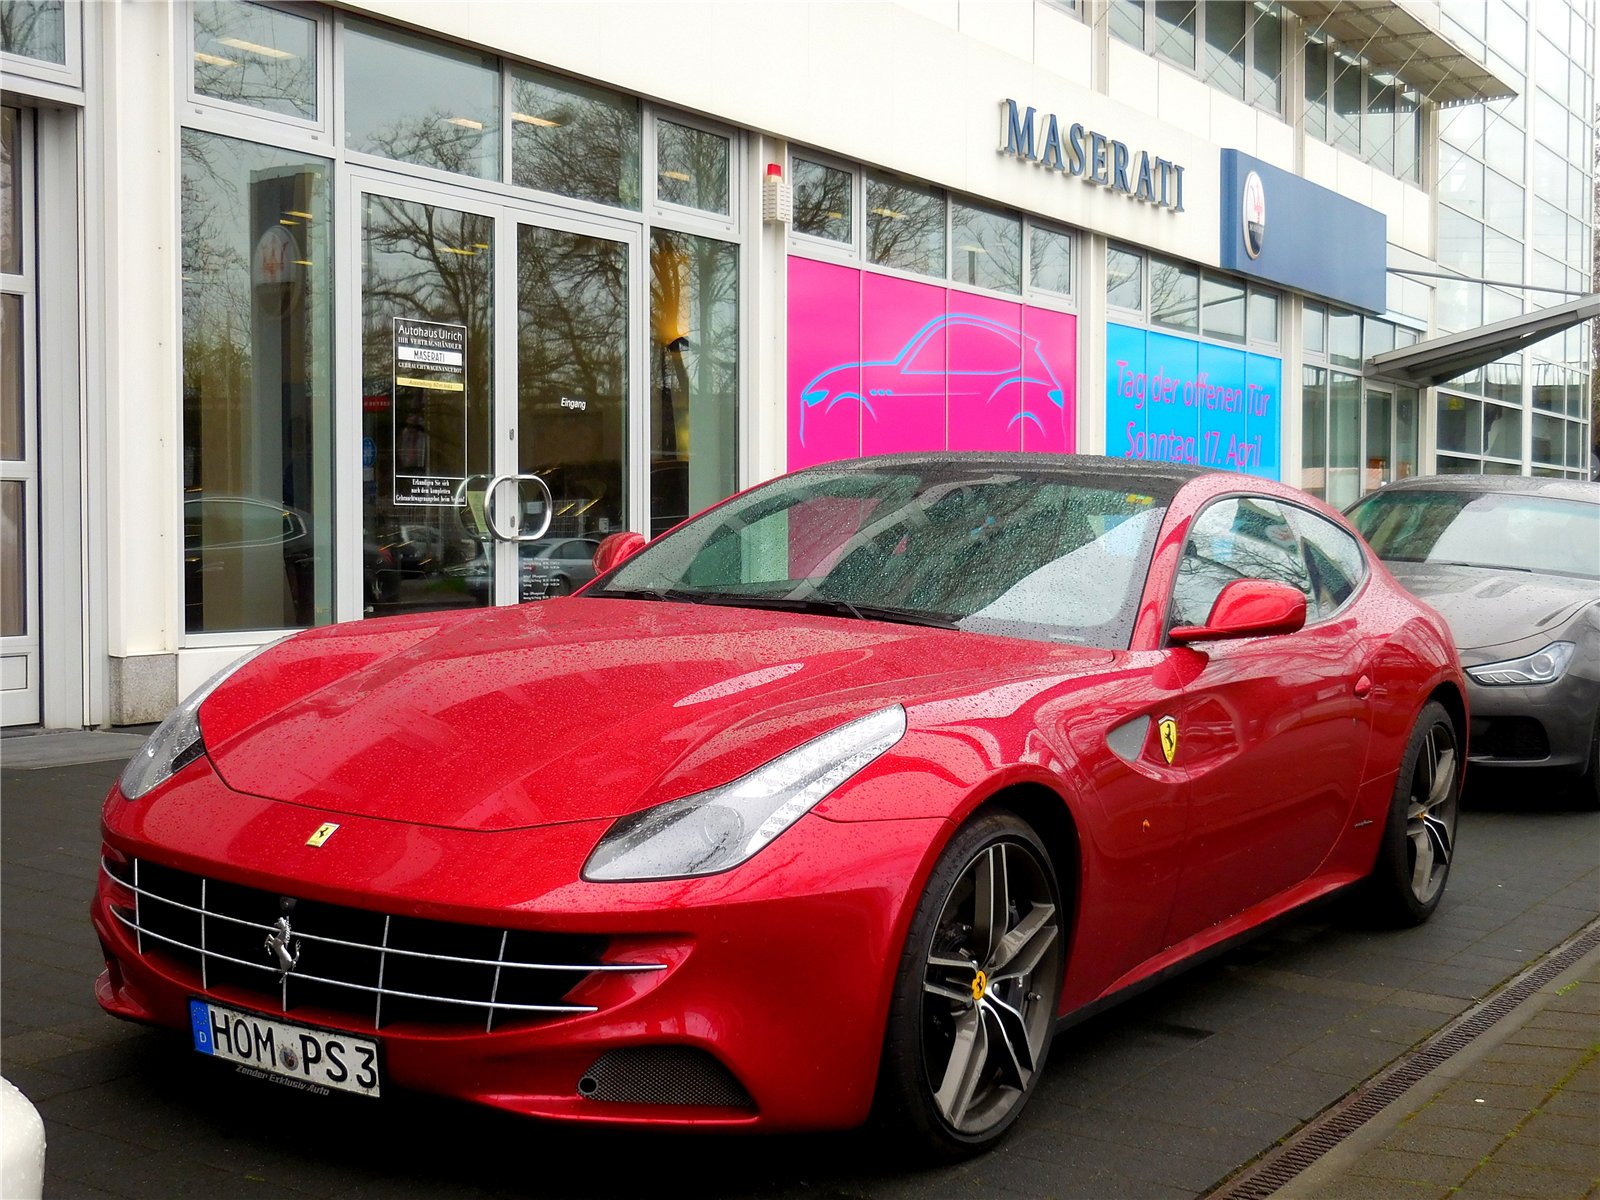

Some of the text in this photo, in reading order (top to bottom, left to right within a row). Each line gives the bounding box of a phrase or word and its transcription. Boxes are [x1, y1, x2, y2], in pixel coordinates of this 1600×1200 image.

[1000, 98, 1185, 213] MASERATI
[398, 325, 463, 341] Autohaus Ulrich
[413, 350, 446, 363] MASERATI
[1116, 359, 1271, 417] Tag der offenen Tür
[560, 397, 587, 411] Eingang
[1204, 431, 1221, 465] 17.
[1225, 433, 1262, 474] April
[199, 1031, 207, 1043] D
[210, 1010, 277, 1067] HOM
[235, 1064, 268, 1080] Zender
